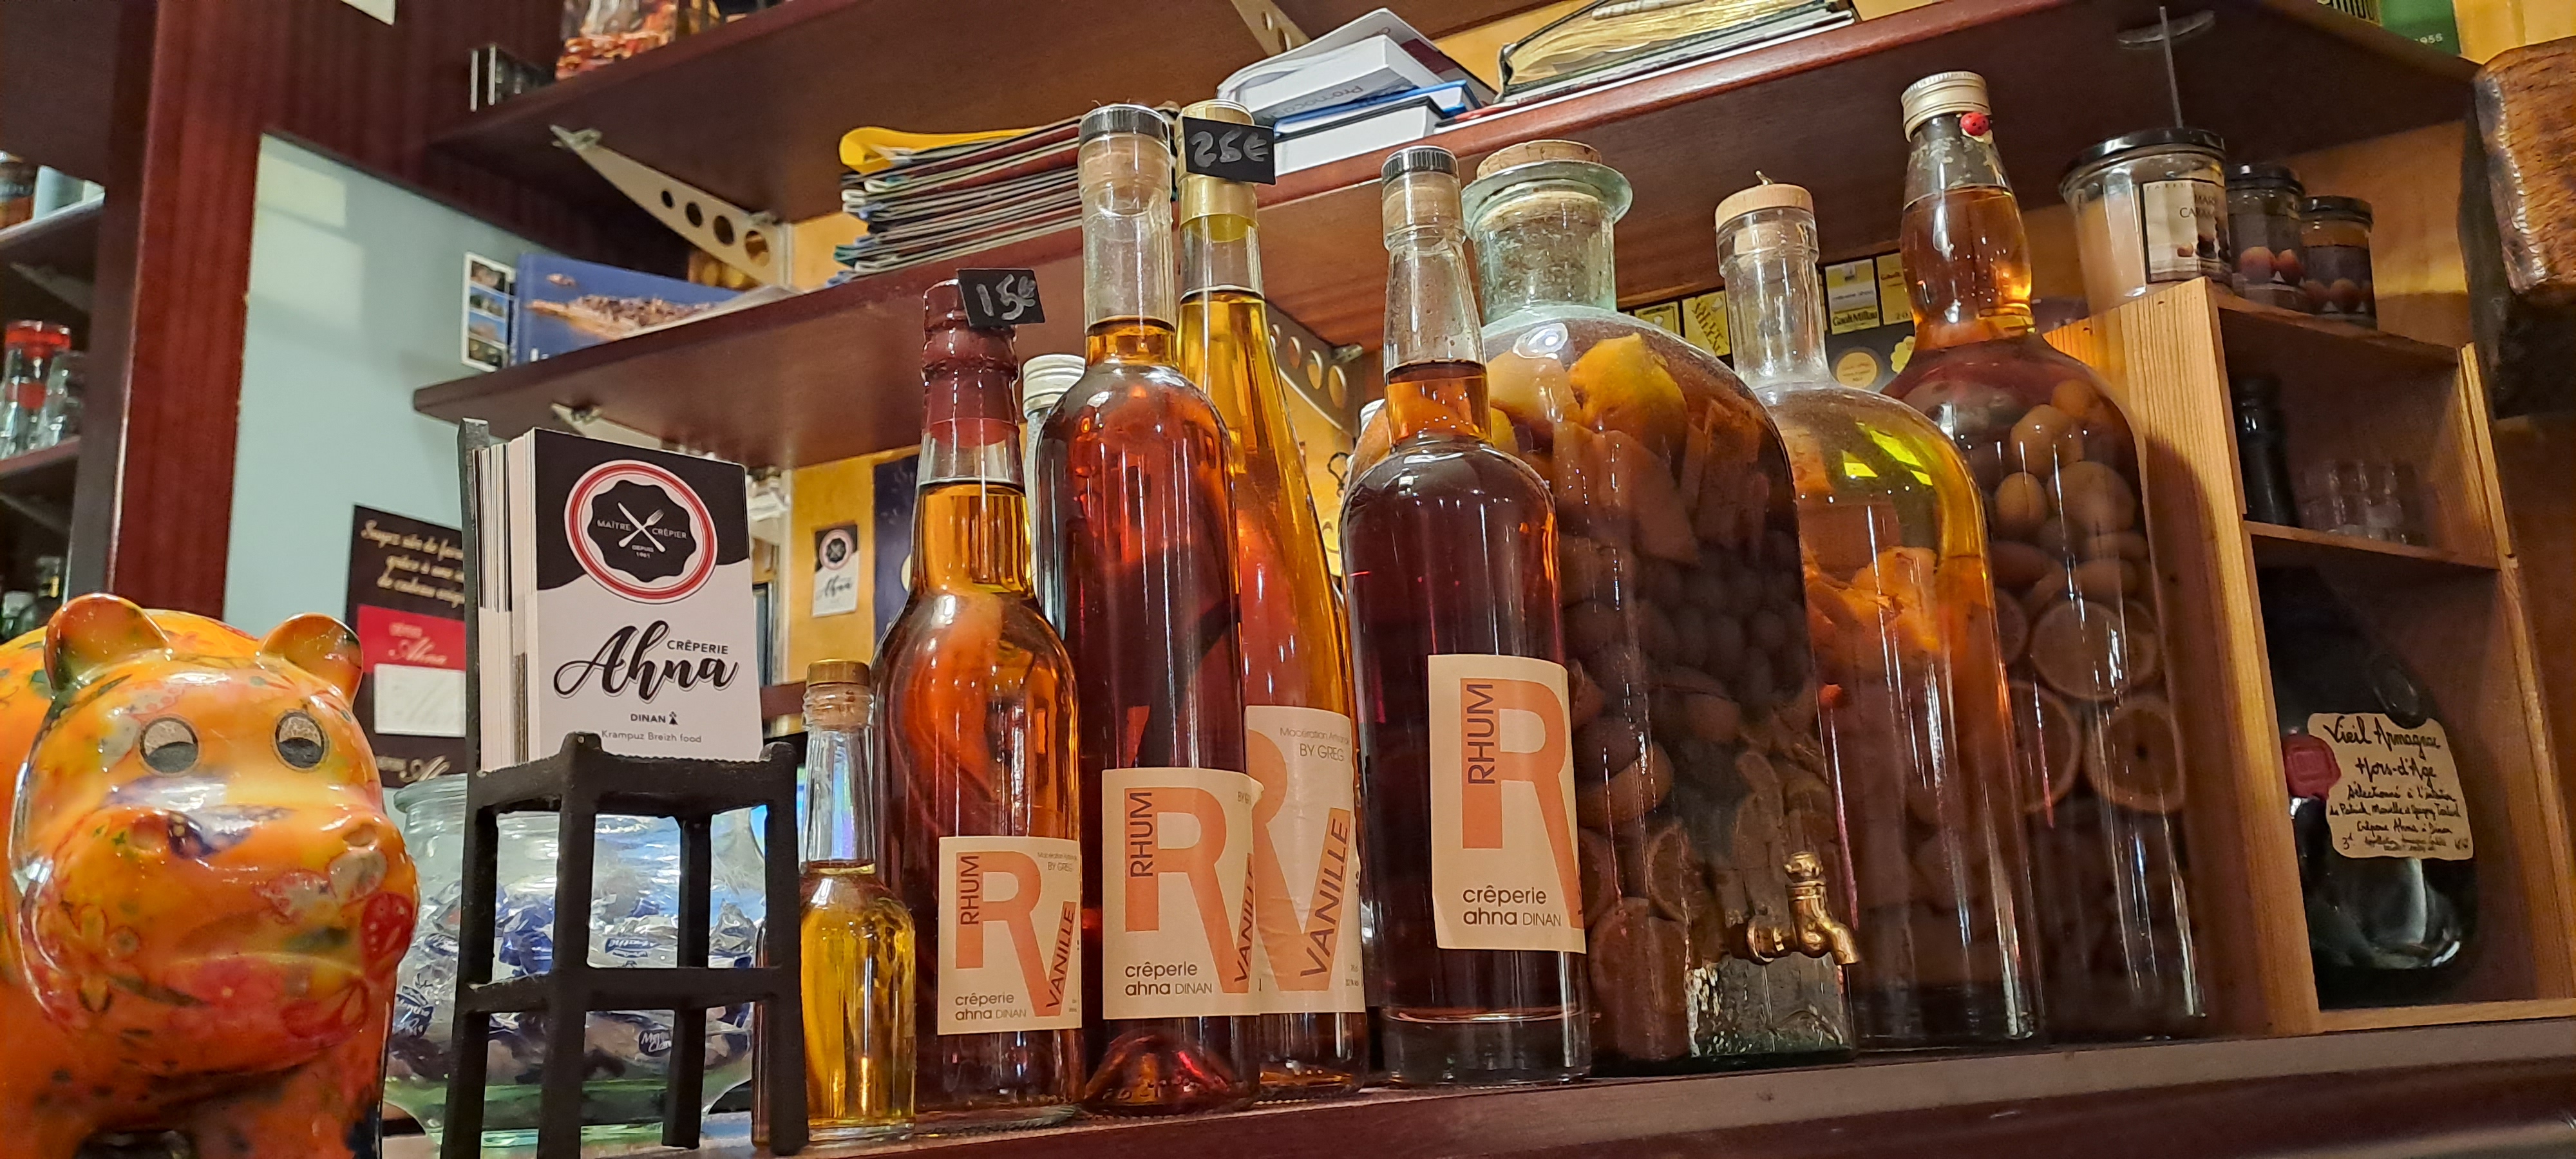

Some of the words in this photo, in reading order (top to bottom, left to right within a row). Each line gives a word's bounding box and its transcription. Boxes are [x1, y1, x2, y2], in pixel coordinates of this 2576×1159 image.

[1189, 127, 1269, 167] 25€
[596, 520, 632, 531] MAÎTRE
[652, 527, 687, 540] CRÊPIER
[667, 639, 729, 655] CRÊPERIE
[553, 619, 739, 703] Ahna
[630, 713, 667, 723] DINAN
[601, 730, 645, 742] Krampuz
[647, 731, 677, 741] Breizh
[679, 733, 703, 743] food
[1466, 683, 1495, 785] RHUM
[2323, 715, 2372, 744] Vieil
[2374, 717, 2441, 760] Armagnac
[1300, 742, 1315, 757] BY
[1317, 744, 1345, 762] GREG
[1129, 791, 1153, 878] RHUM
[960, 855, 980, 926] RHUM
[1300, 818, 1349, 978] VANILLE
[1463, 885, 1547, 907] crêperie
[1463, 907, 1517, 925] ahna
[1522, 912, 1562, 927] DINAN
[1045, 907, 1075, 1008] VANILLE
[1124, 961, 1198, 980] crêperie
[1124, 981, 1171, 996] ahna
[1175, 983, 1213, 995] DINAN
[955, 992, 1015, 1008] crêperie
[955, 1008, 992, 1021] ahna
[996, 1009, 1027, 1019] DINAN
